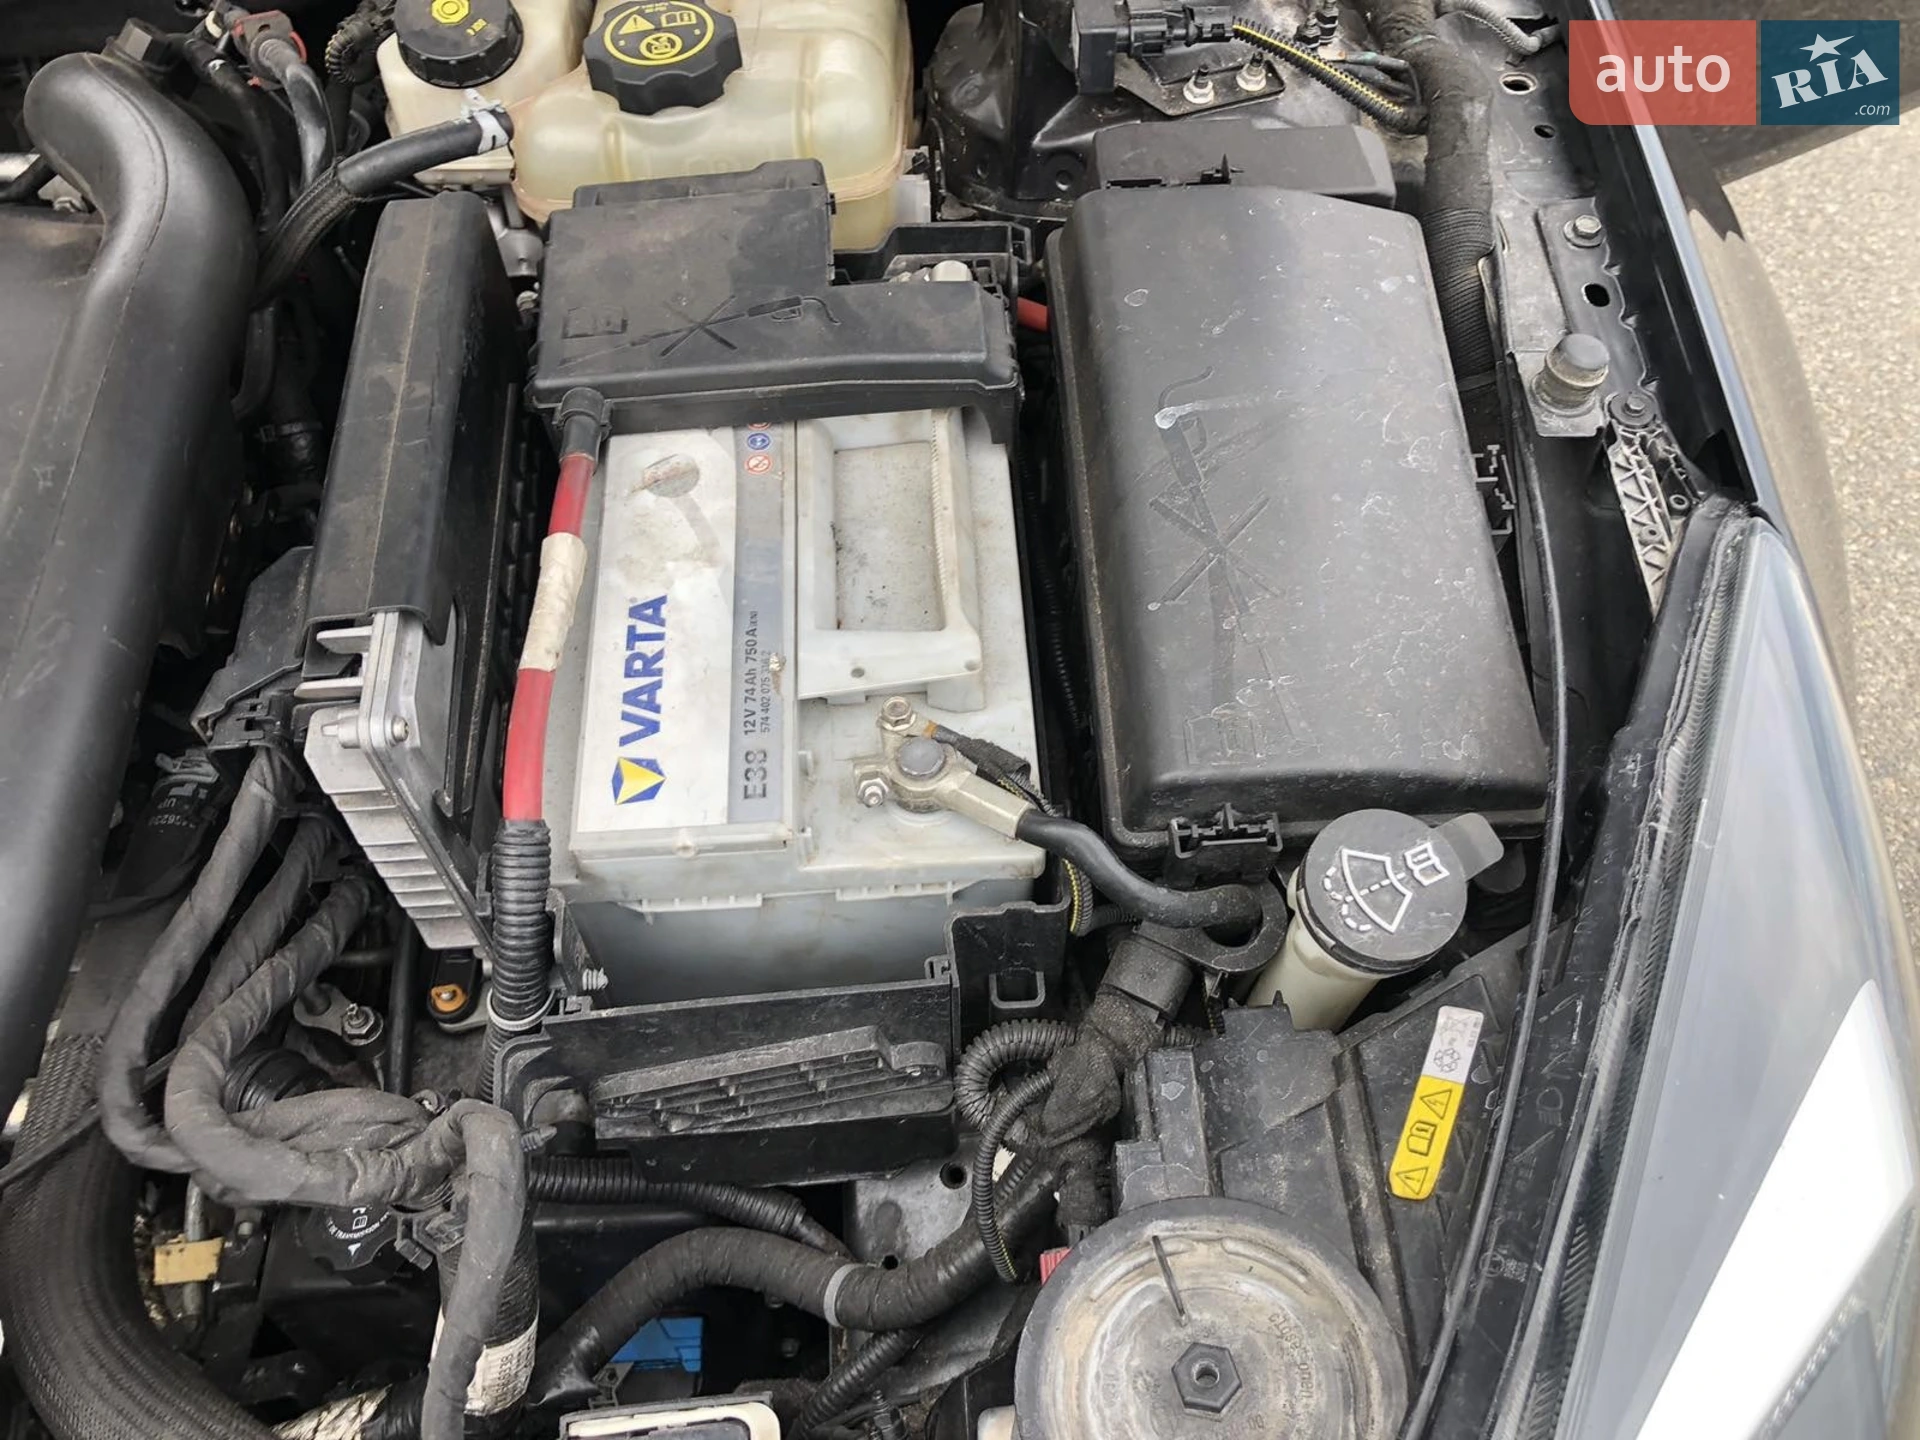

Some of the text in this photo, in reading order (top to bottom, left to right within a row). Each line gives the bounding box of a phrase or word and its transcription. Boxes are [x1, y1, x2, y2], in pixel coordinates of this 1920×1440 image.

[618, 594, 669, 748] VARTA
[760, 696, 771, 714] 402
[743, 708, 757, 736] 12V
[760, 716, 771, 733] 574
[743, 749, 768, 800] E38
